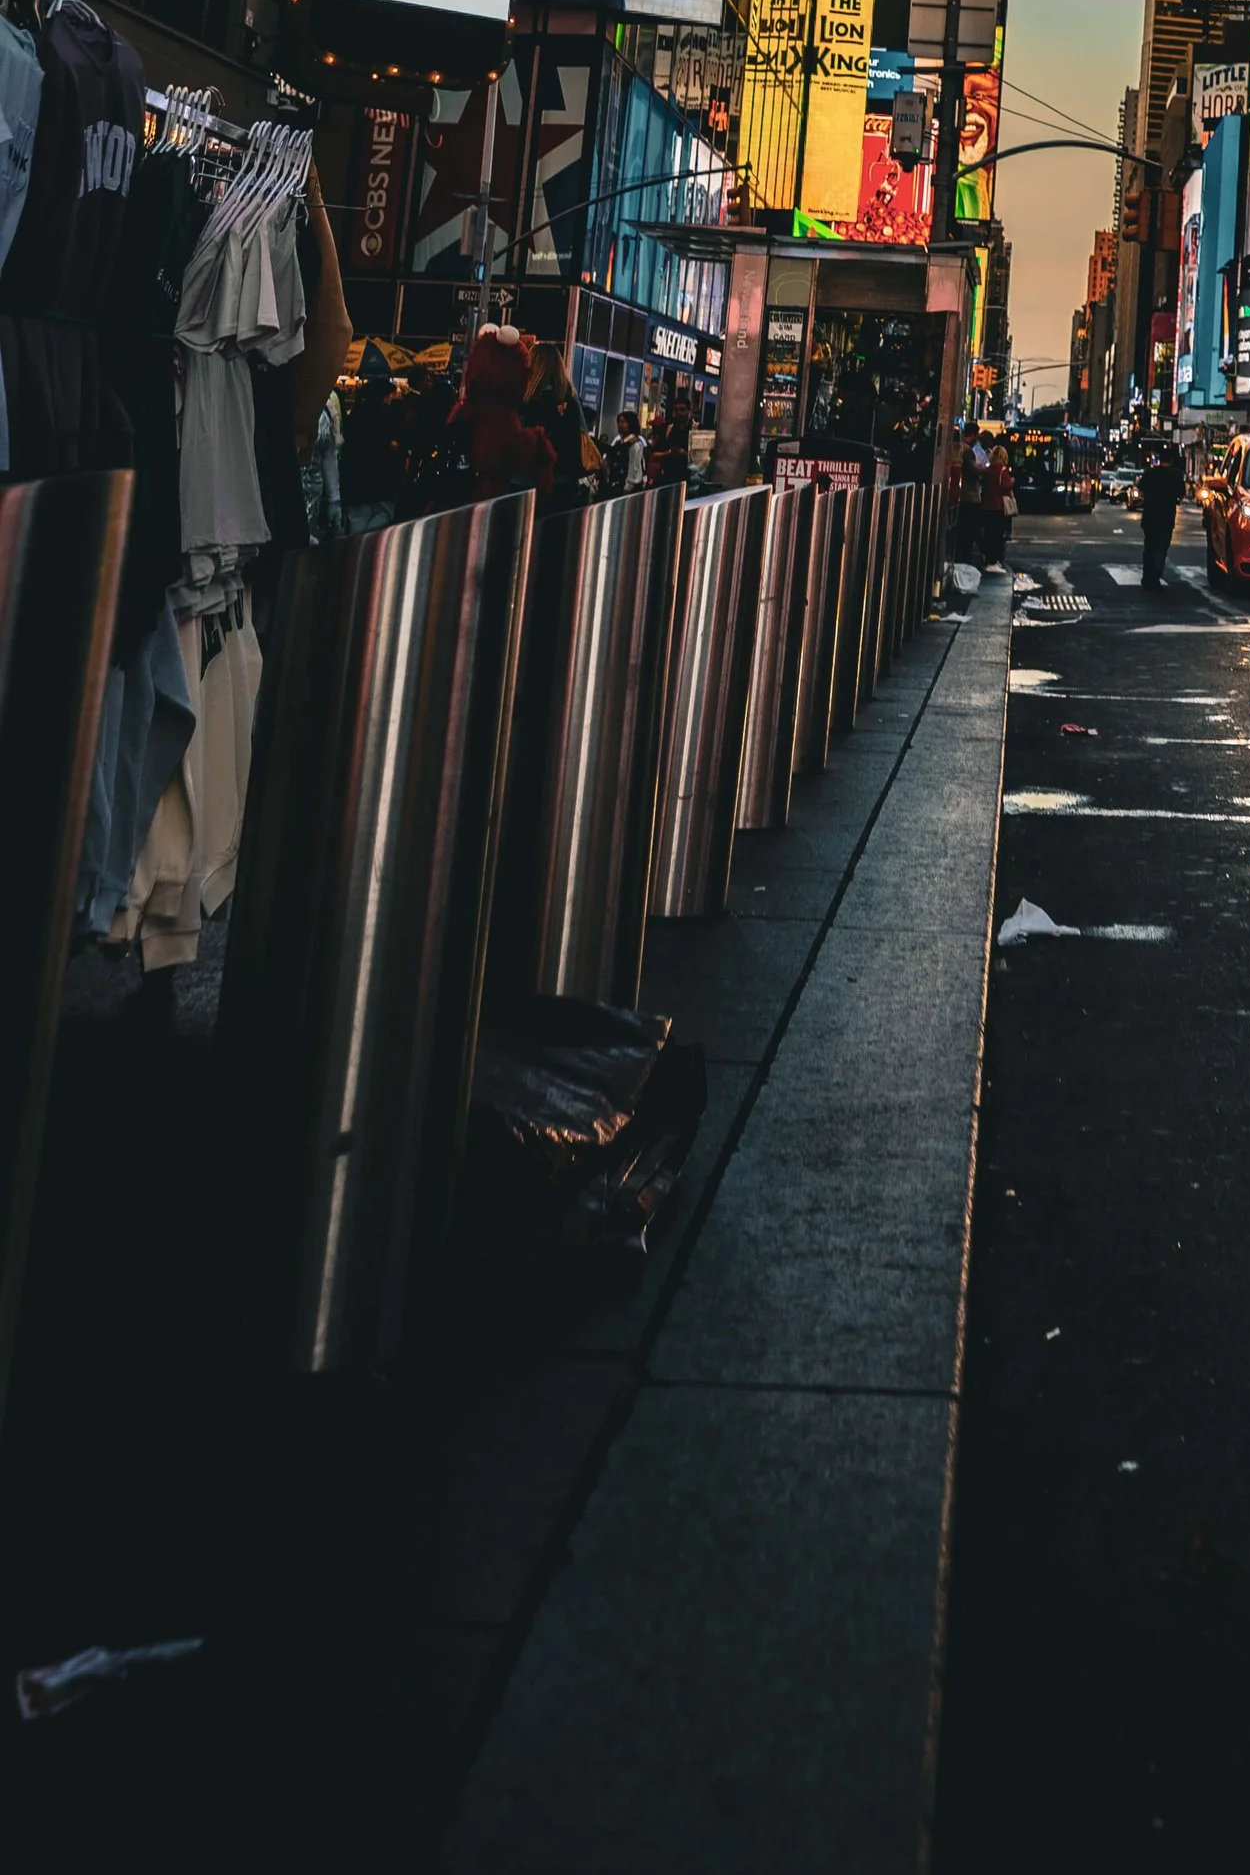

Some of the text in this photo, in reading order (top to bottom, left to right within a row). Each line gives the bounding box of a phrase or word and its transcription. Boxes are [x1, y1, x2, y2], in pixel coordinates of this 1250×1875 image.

[1202, 66, 1246, 92] LITTLE
[365, 172, 389, 226] CBS
[651, 325, 698, 366] SKECHERS
[776, 457, 861, 478] BEAT THRILLER
